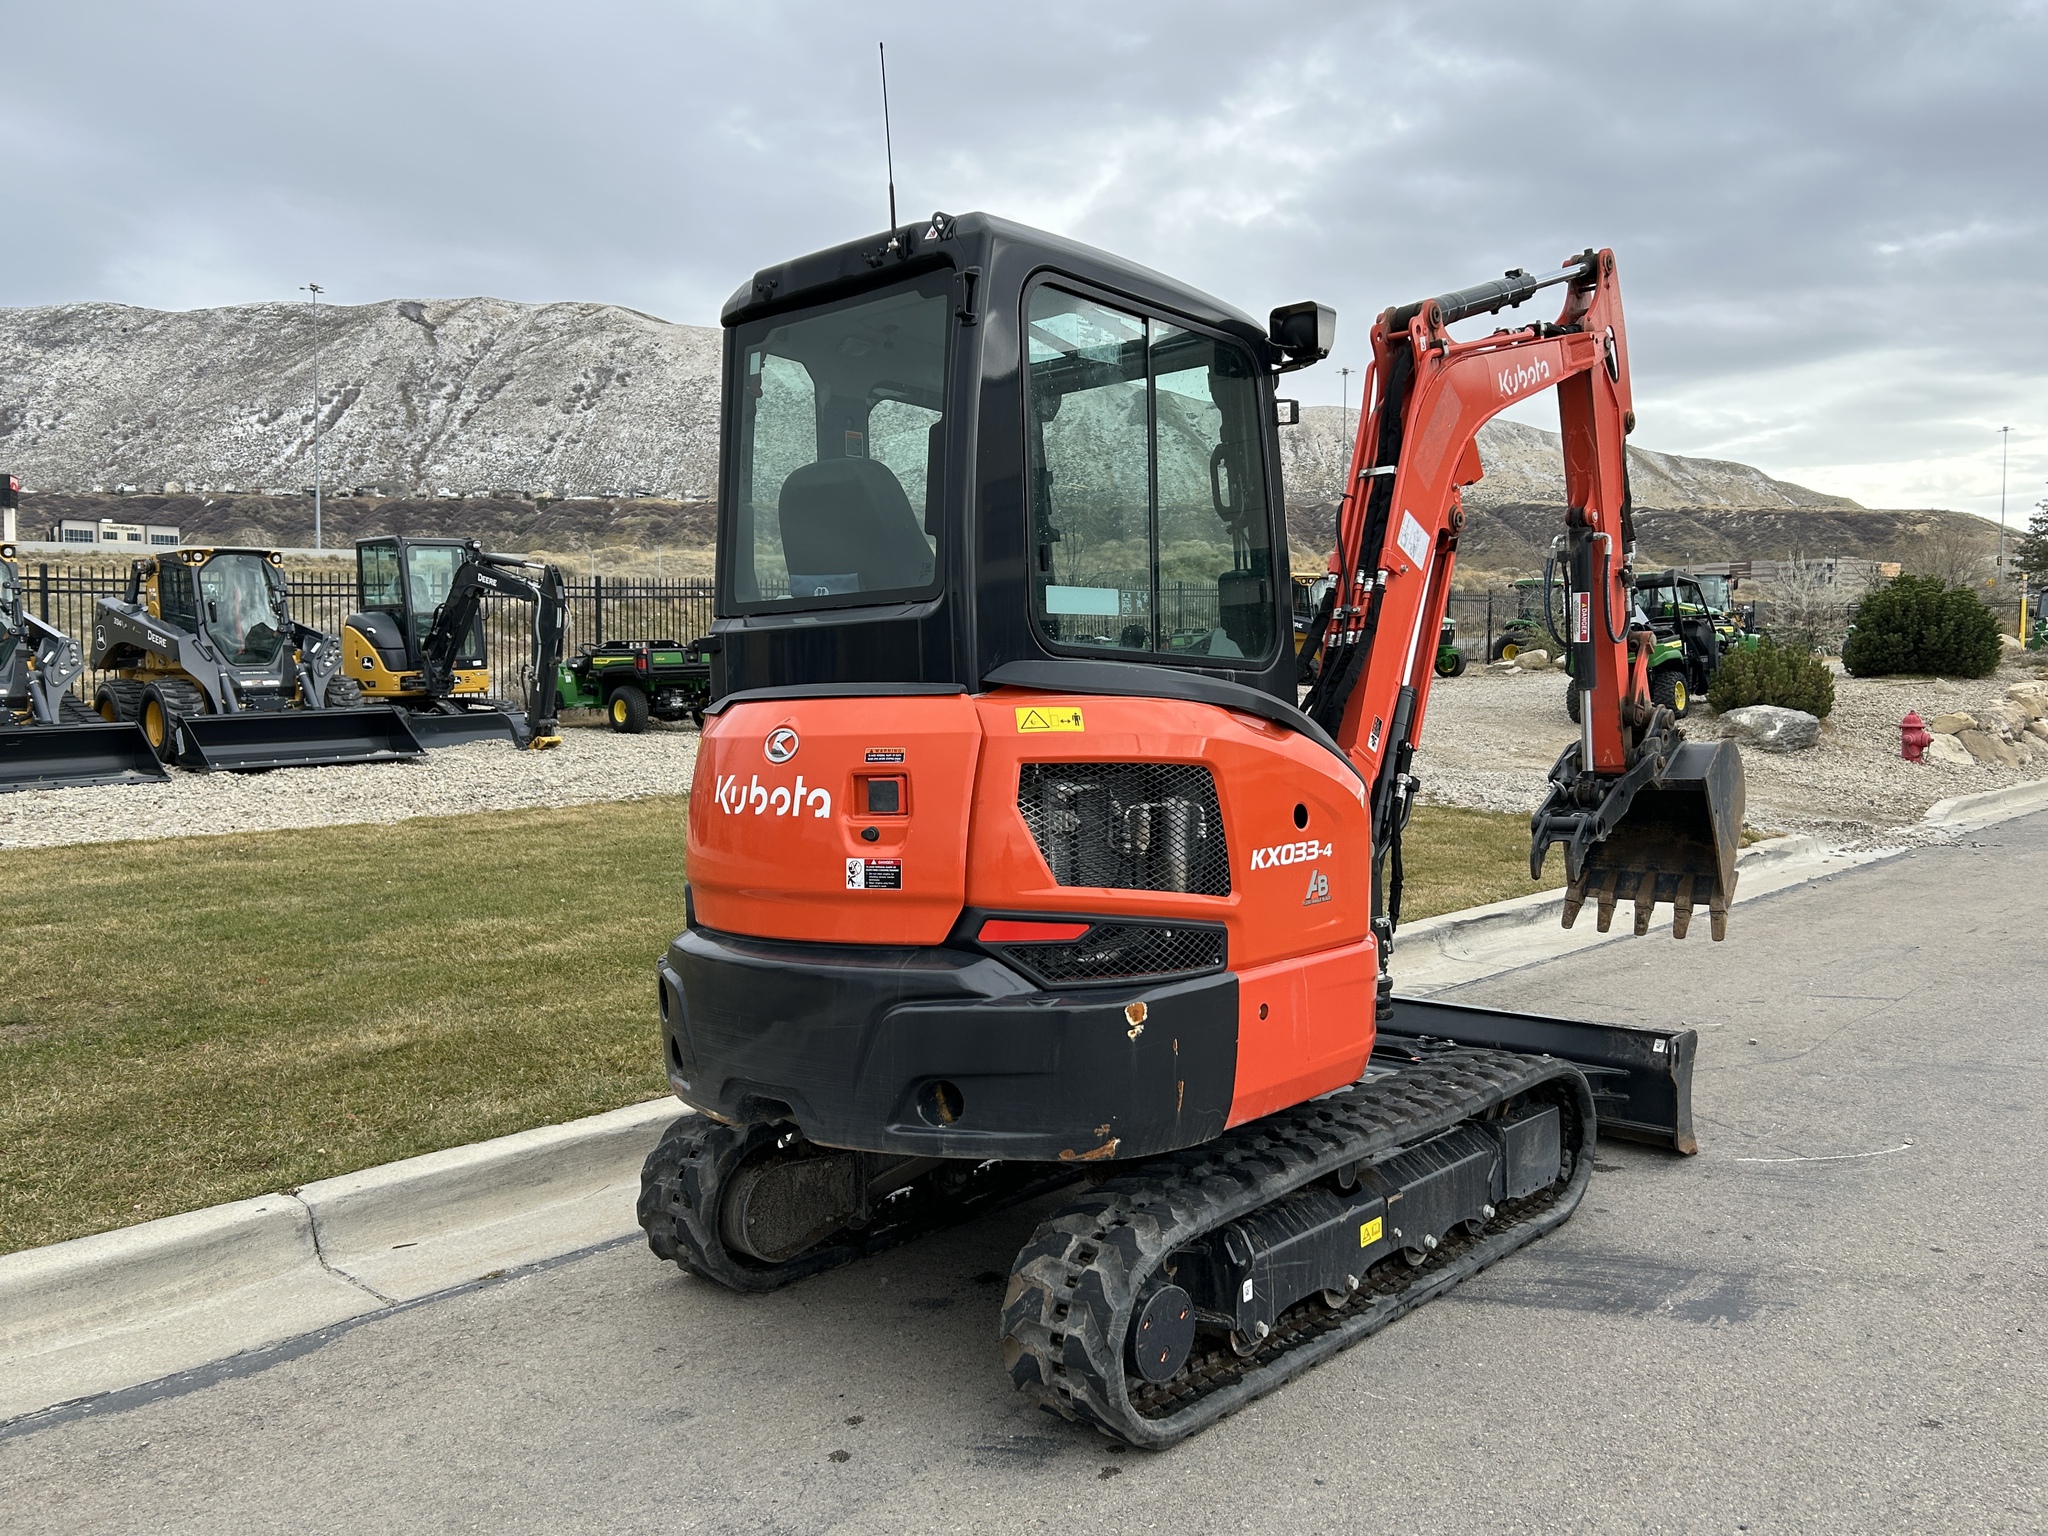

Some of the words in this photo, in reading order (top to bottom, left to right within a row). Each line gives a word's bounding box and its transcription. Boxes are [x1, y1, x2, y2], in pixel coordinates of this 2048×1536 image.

[1498, 356, 1550, 396] Kubota
[477, 573, 498, 587] DEERE
[147, 629, 167, 648] DEERE
[714, 774, 832, 819] Kubota
[1250, 839, 1333, 871] KX033-4
